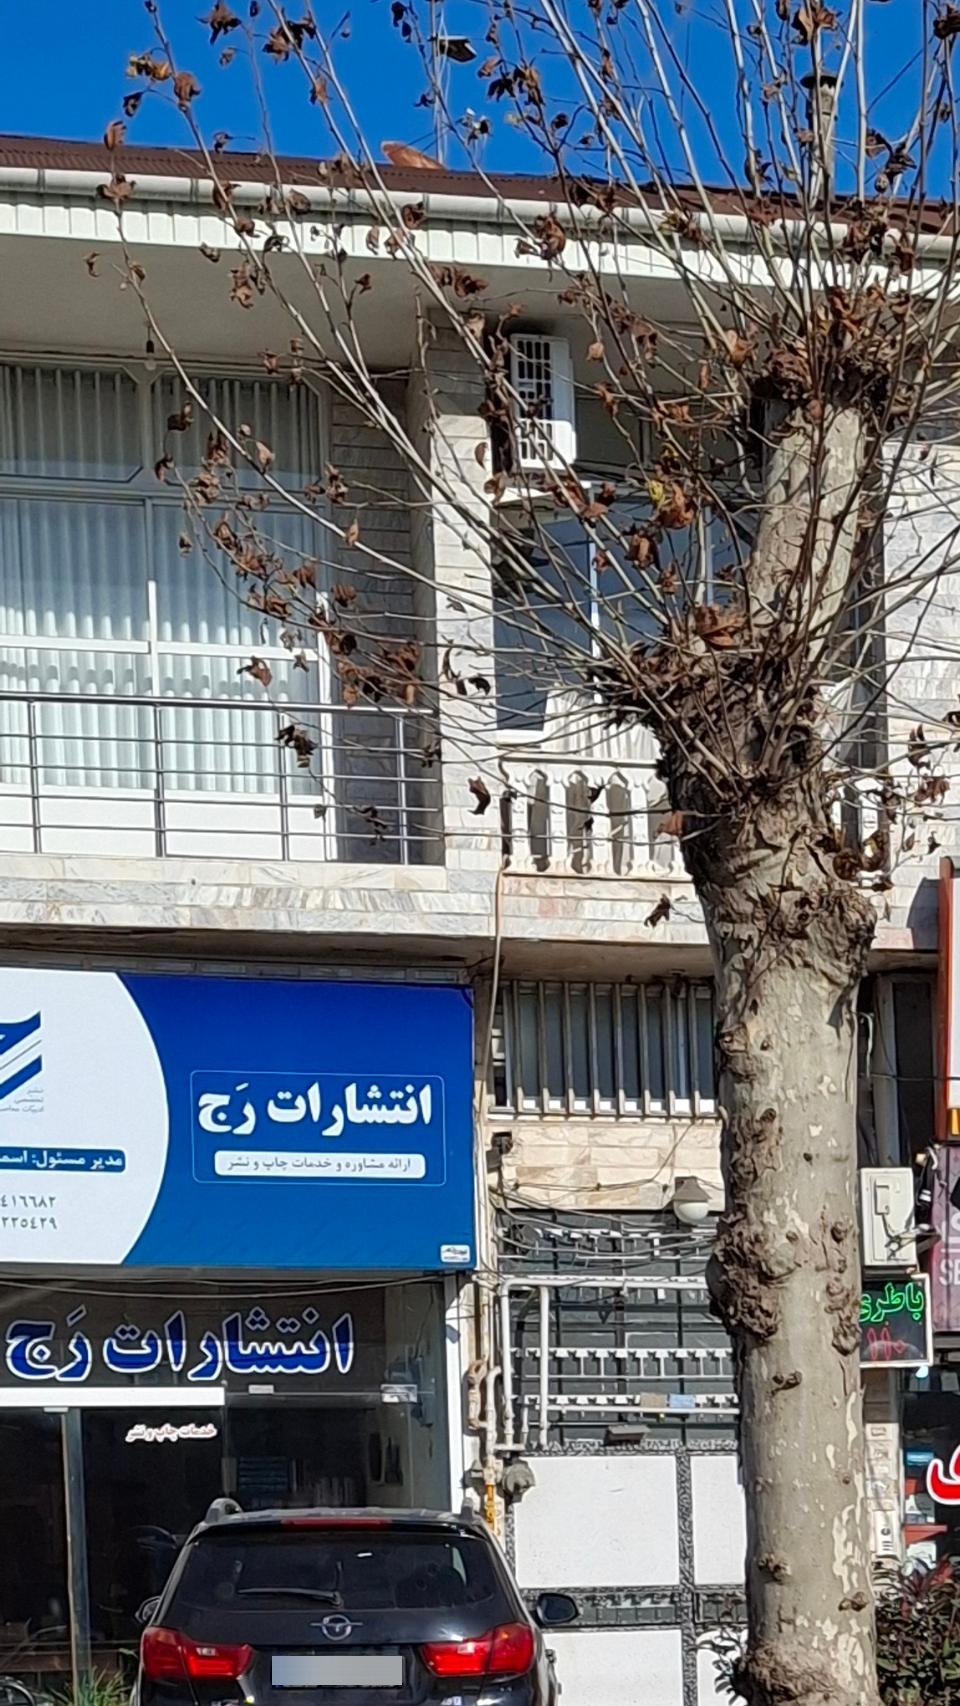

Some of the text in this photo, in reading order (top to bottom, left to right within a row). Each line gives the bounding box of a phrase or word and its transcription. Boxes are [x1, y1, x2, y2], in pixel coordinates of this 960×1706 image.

[266, 1081, 432, 1137] انتشارات
[89, 1155, 123, 1170] مدیر
[291, 1157, 332, 1169] خدمات
[102, 1306, 355, 1382] انتشارات
